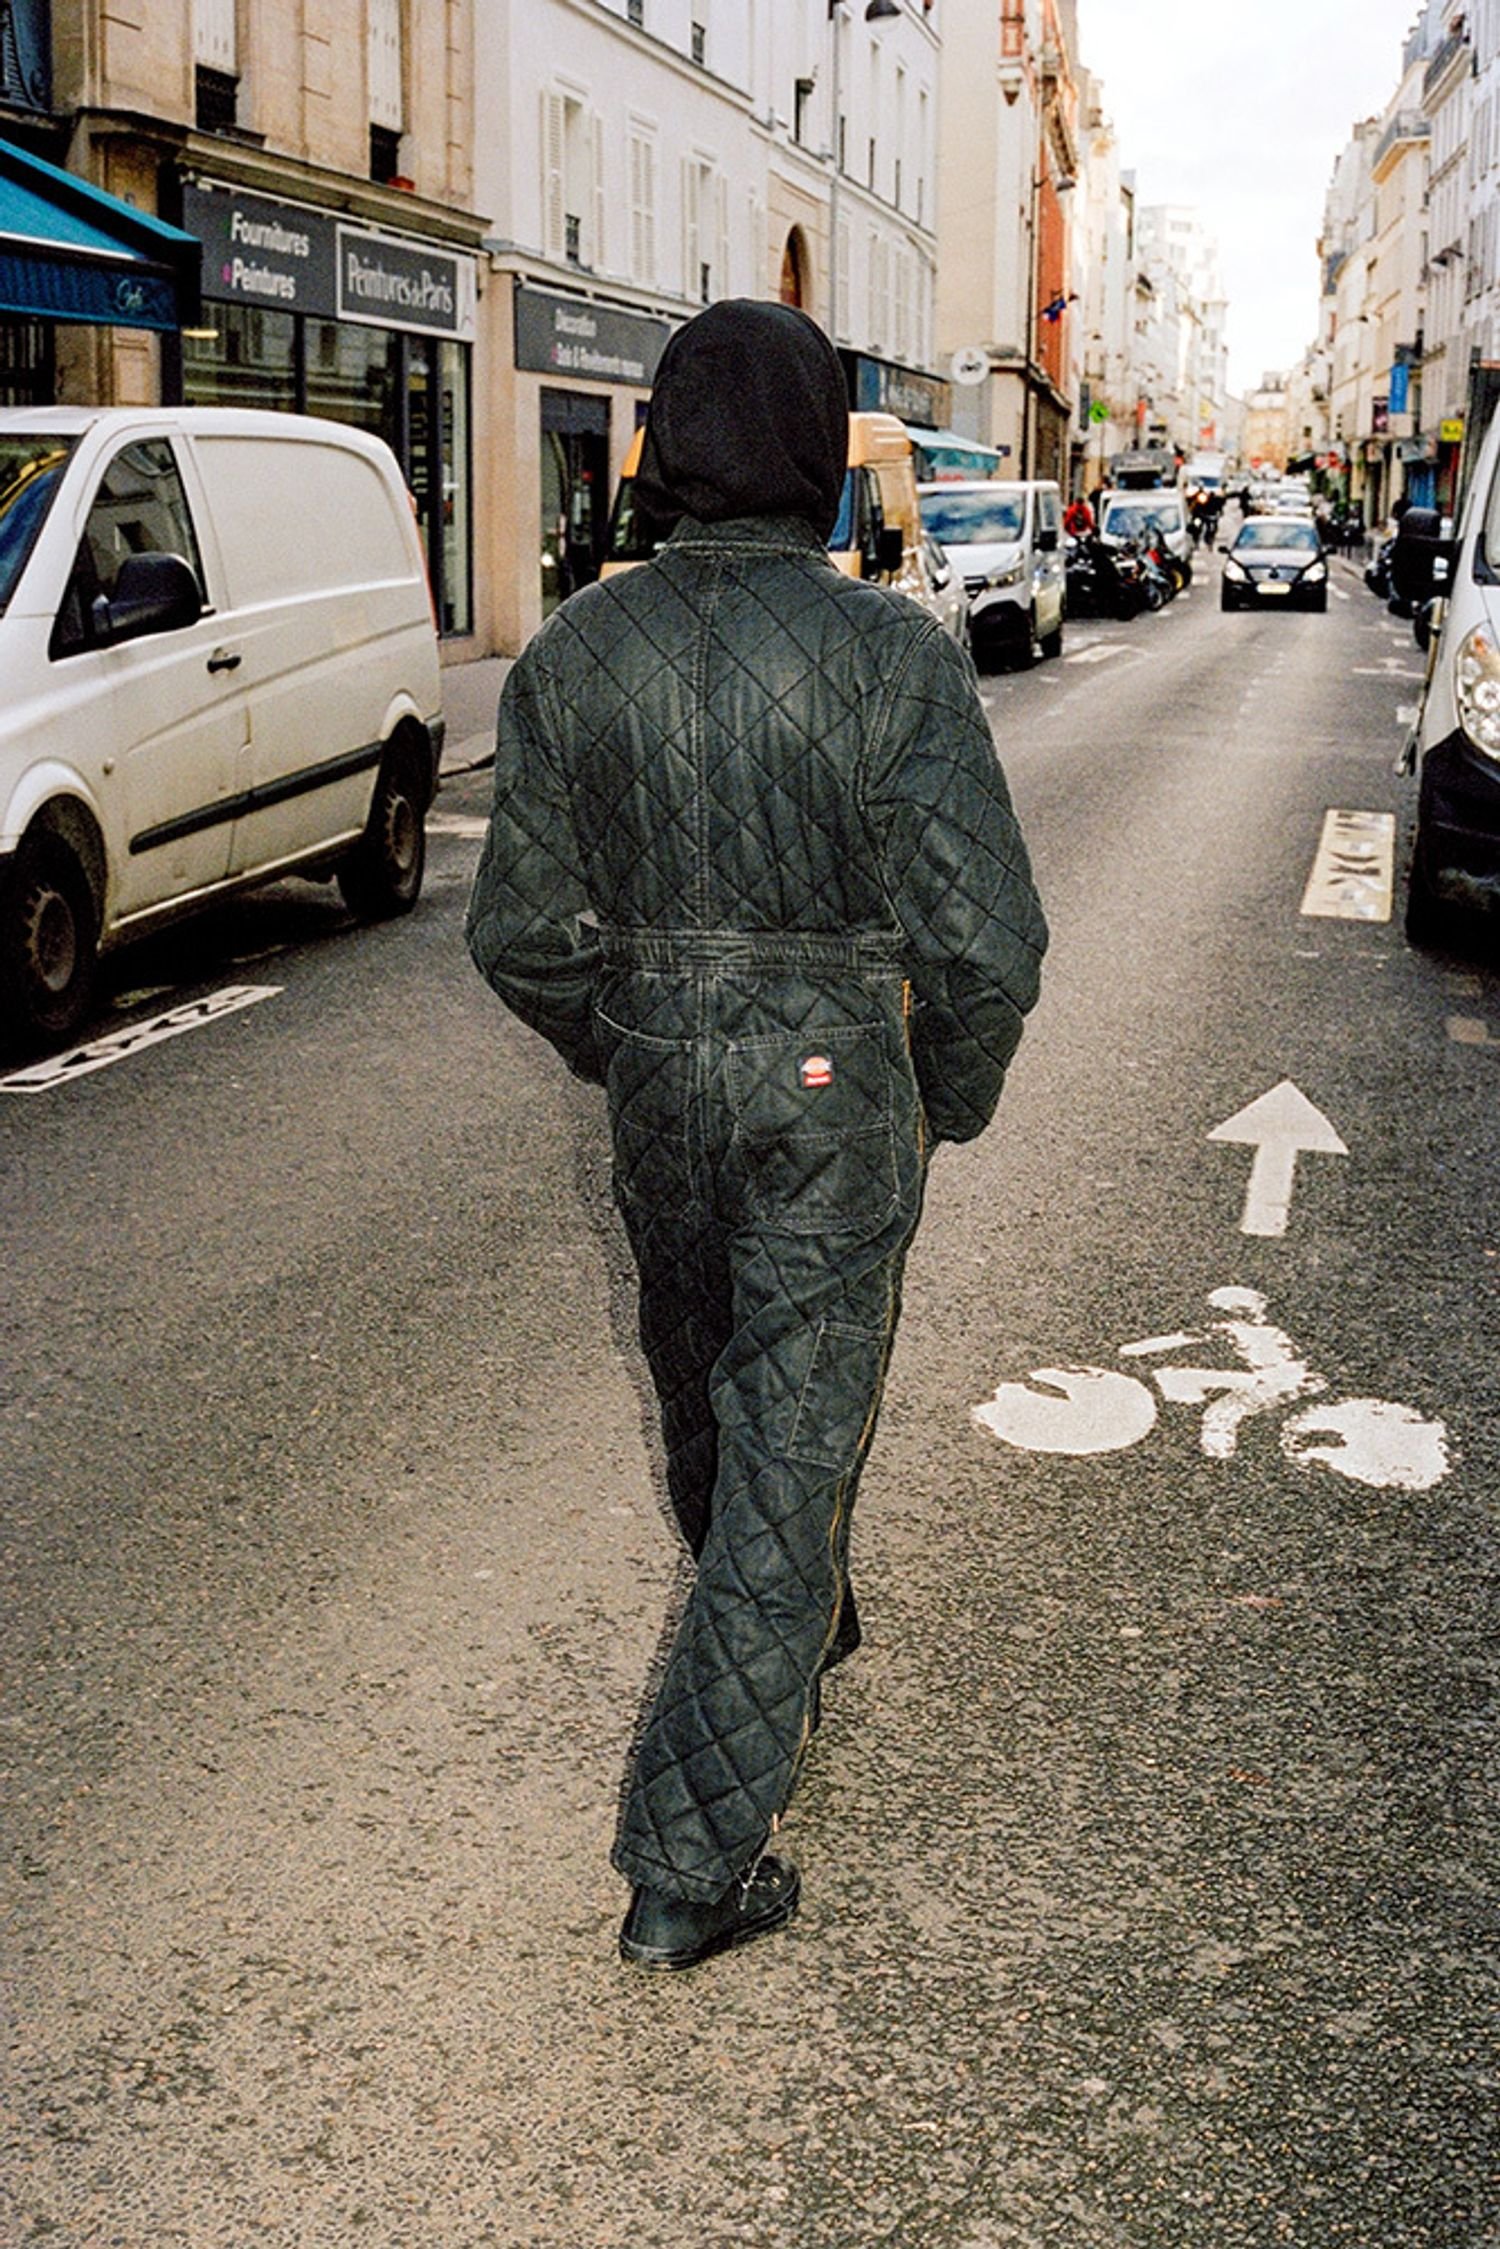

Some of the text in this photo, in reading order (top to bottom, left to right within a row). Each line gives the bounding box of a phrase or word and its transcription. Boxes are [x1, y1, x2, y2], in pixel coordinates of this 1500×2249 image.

[231, 211, 309, 257] Fournitures
[231, 257, 296, 300] Peintures
[348, 252, 411, 305] Peintures
[422, 269, 453, 314] Paris
